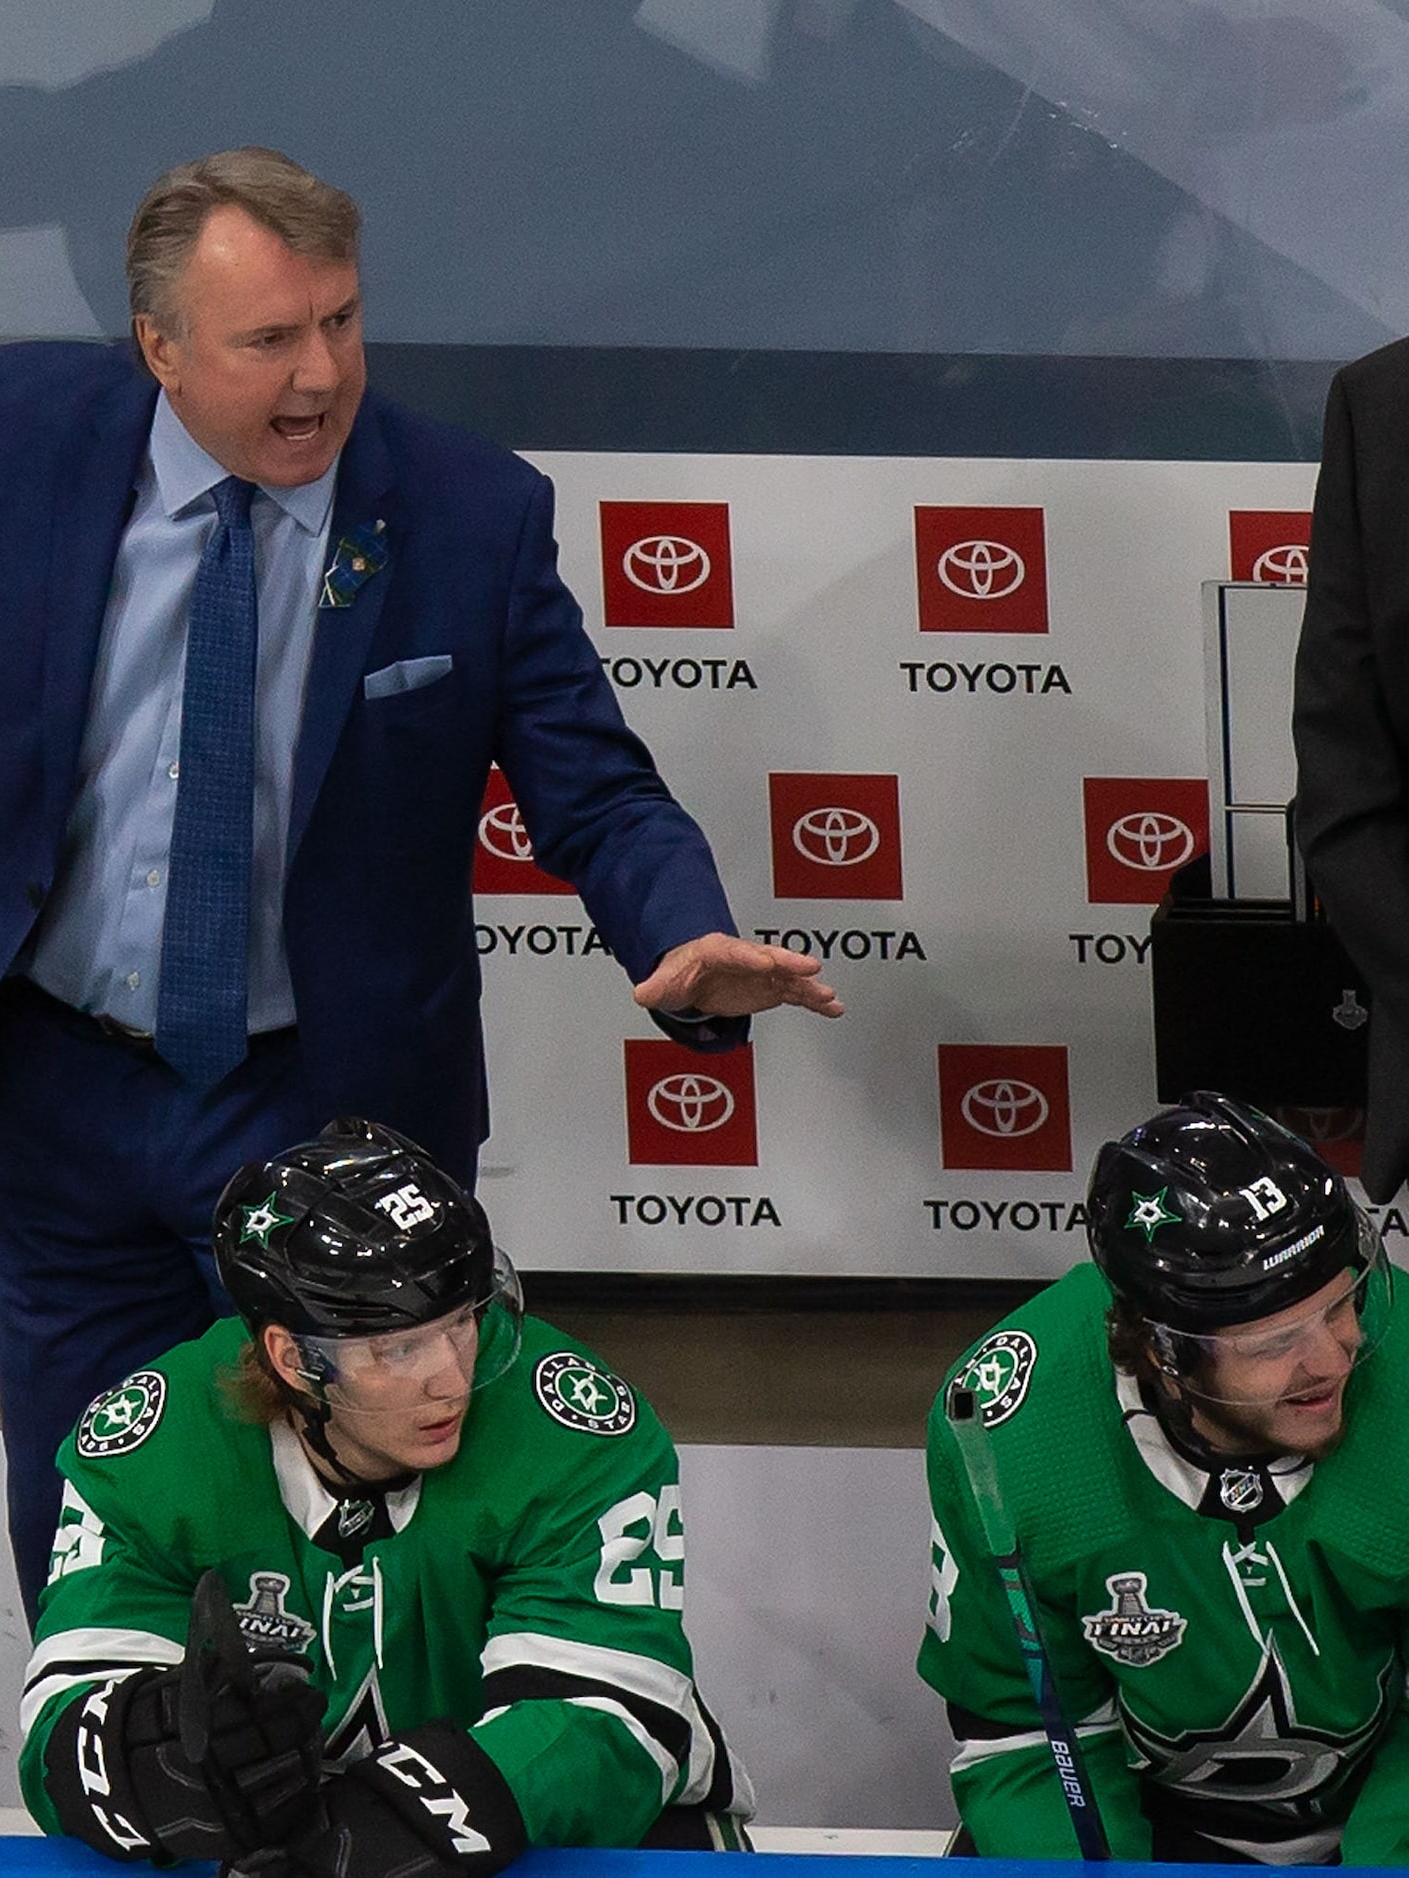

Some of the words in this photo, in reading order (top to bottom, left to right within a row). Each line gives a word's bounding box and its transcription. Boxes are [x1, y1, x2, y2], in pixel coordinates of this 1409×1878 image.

[899, 662, 1072, 695] TOYOTA
[475, 925, 614, 956] OYOTA
[1068, 933, 1152, 964] TOY
[379, 1183, 435, 1231] 25
[609, 1195, 782, 1227] TOYOTA
[1238, 1176, 1287, 1221] 13
[1263, 1224, 1325, 1271] WARRIOR
[995, 1335, 1030, 1410] DALLAS
[587, 1384, 629, 1430] STARS
[1050, 1740, 1087, 1808] BAUER
[377, 1741, 492, 1854] CM
